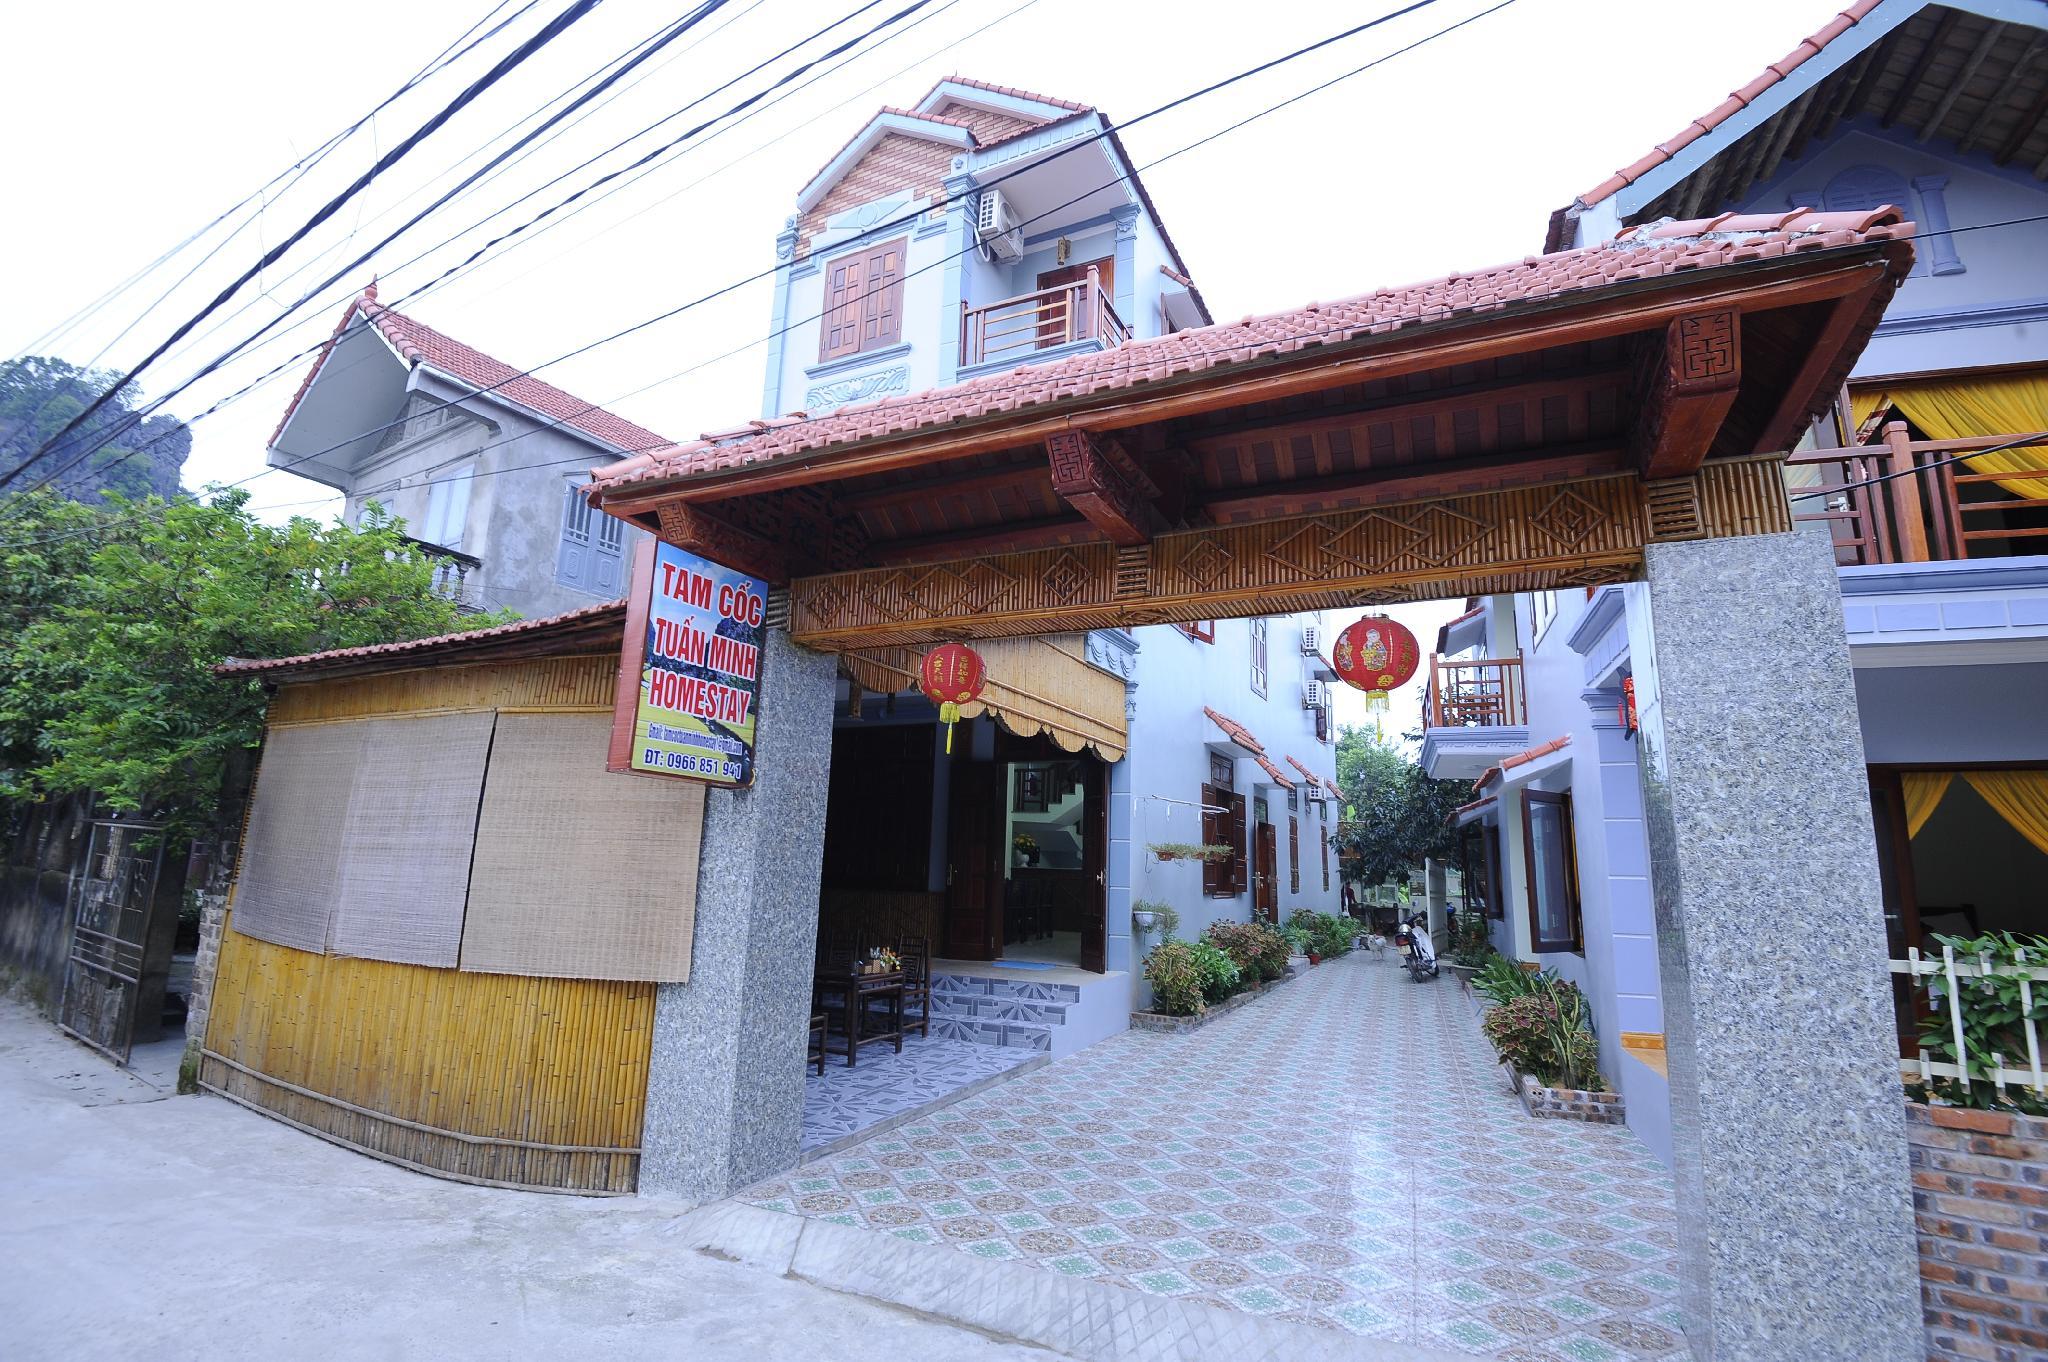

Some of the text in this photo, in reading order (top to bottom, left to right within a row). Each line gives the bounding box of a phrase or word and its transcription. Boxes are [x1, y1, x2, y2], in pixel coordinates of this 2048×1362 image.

[662, 562, 762, 626] TAM CỐC
[655, 616, 757, 679] TUẤN MINH
[649, 670, 751, 725] HOMESTAY
[645, 749, 742, 779] ĐT: 0966 851 941
